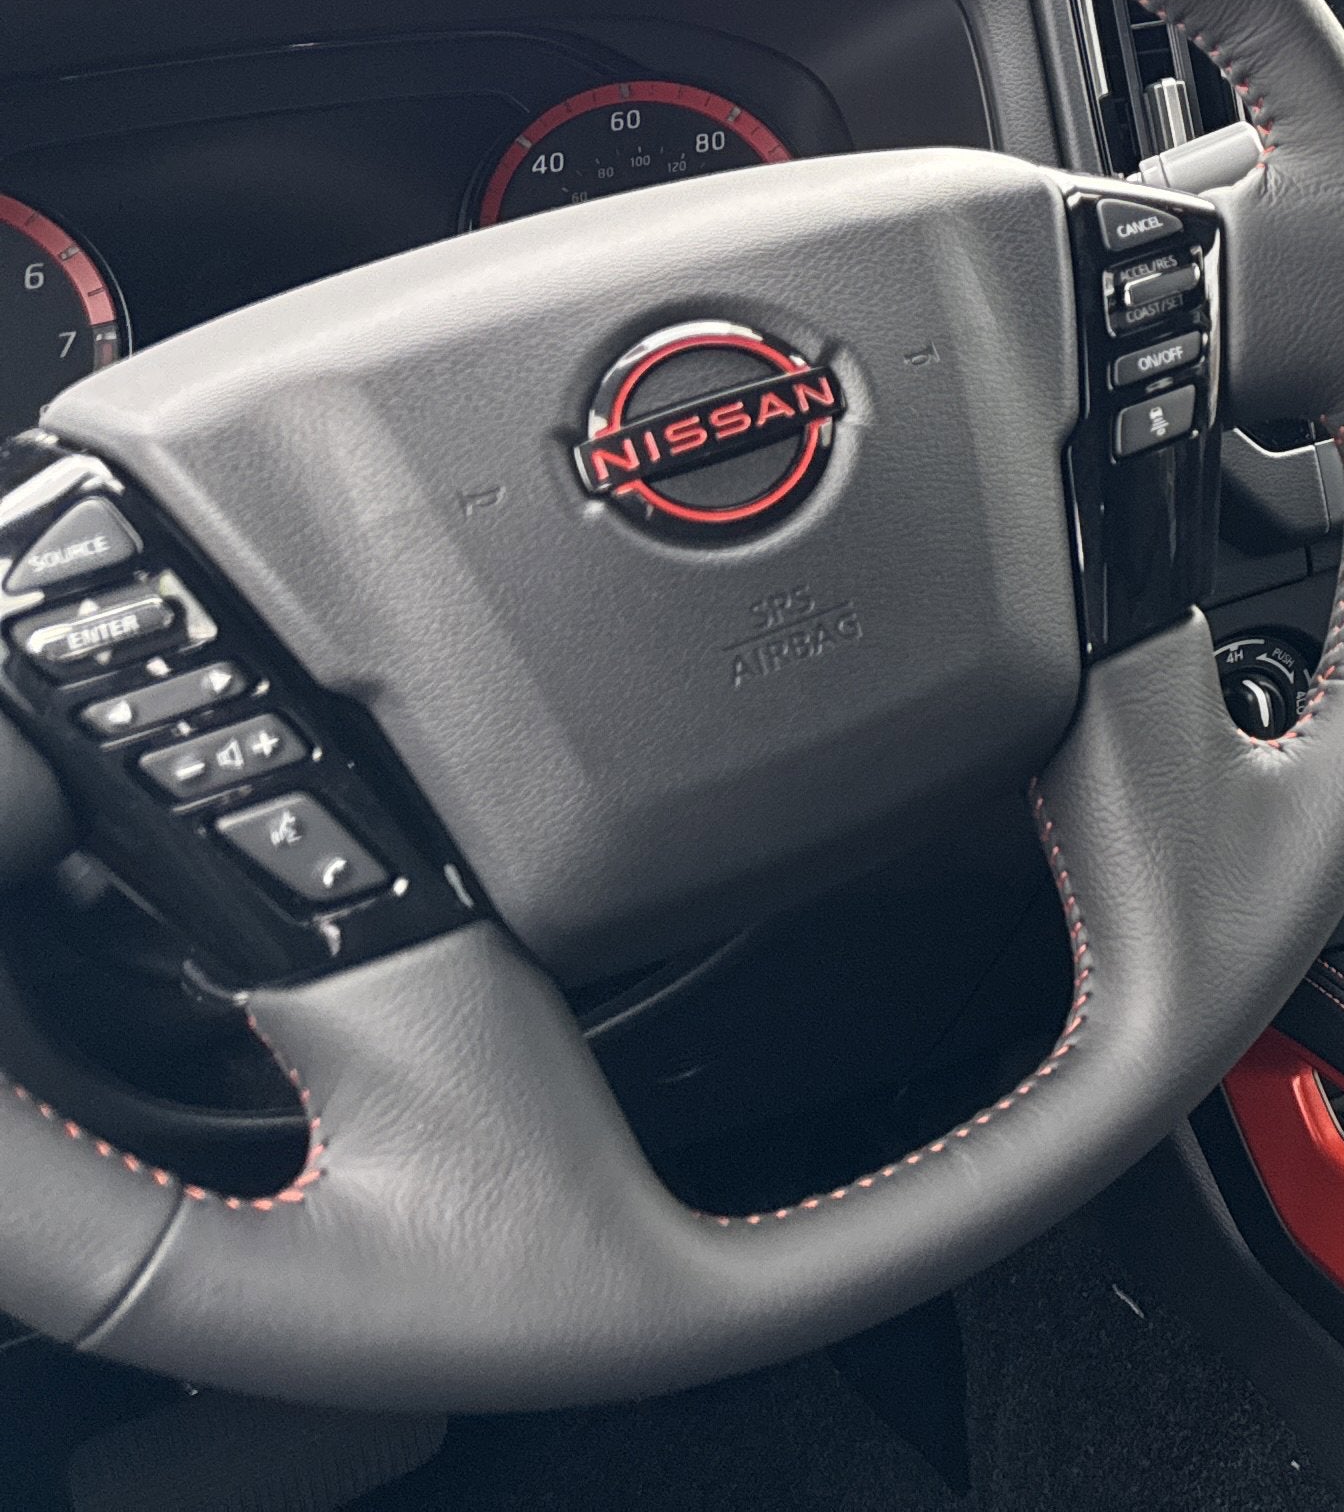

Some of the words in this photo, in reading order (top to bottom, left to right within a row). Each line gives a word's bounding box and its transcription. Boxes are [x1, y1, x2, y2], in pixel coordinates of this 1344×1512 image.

[610, 110, 640, 131] 60
[695, 131, 725, 153] 80
[532, 152, 564, 174] 40
[597, 166, 614, 179] 80
[630, 155, 651, 168] 100
[667, 160, 686, 173] 120
[1116, 216, 1163, 238] CANCEL
[24, 263, 45, 290] 6
[1120, 255, 1177, 281] ACCEL/RES
[1126, 294, 1184, 323] COAST/SET
[59, 331, 78, 359] 7
[1138, 346, 1184, 370] ON/OFF
[590, 376, 835, 482] NISSAN
[29, 535, 111, 572] SOURCE
[67, 615, 139, 650] ENTER
[1226, 649, 1243, 664] 4H
[1271, 648, 1295, 667] PUSH
